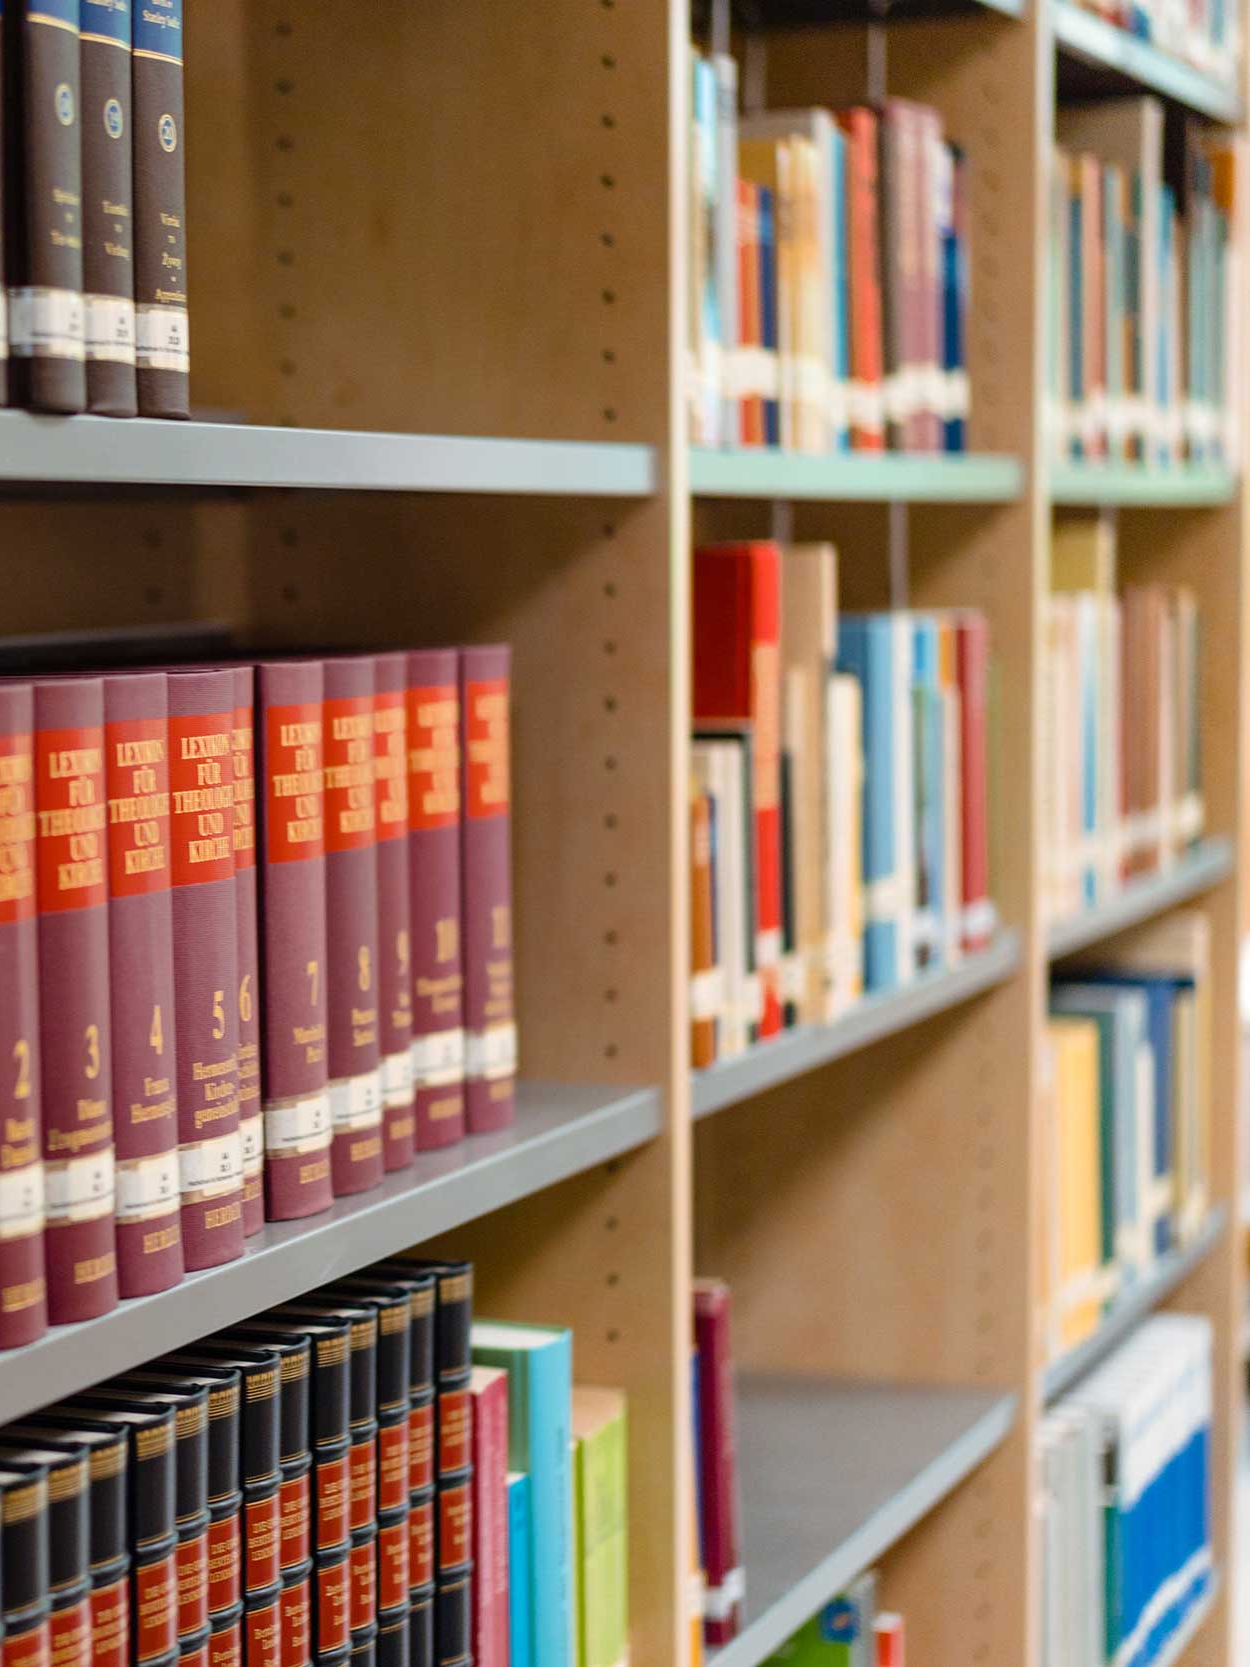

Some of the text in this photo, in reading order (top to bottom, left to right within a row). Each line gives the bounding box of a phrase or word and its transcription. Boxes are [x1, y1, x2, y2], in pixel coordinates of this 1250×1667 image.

[196, 758, 222, 786] FÜR
[197, 812, 224, 837] UND
[306, 960, 319, 1007] 7
[357, 945, 371, 992] 8
[212, 990, 225, 1040] 5
[238, 974, 252, 1022] 6
[85, 1023, 101, 1080] 3
[149, 1004, 164, 1056] 4
[13, 1039, 31, 1100] 2
